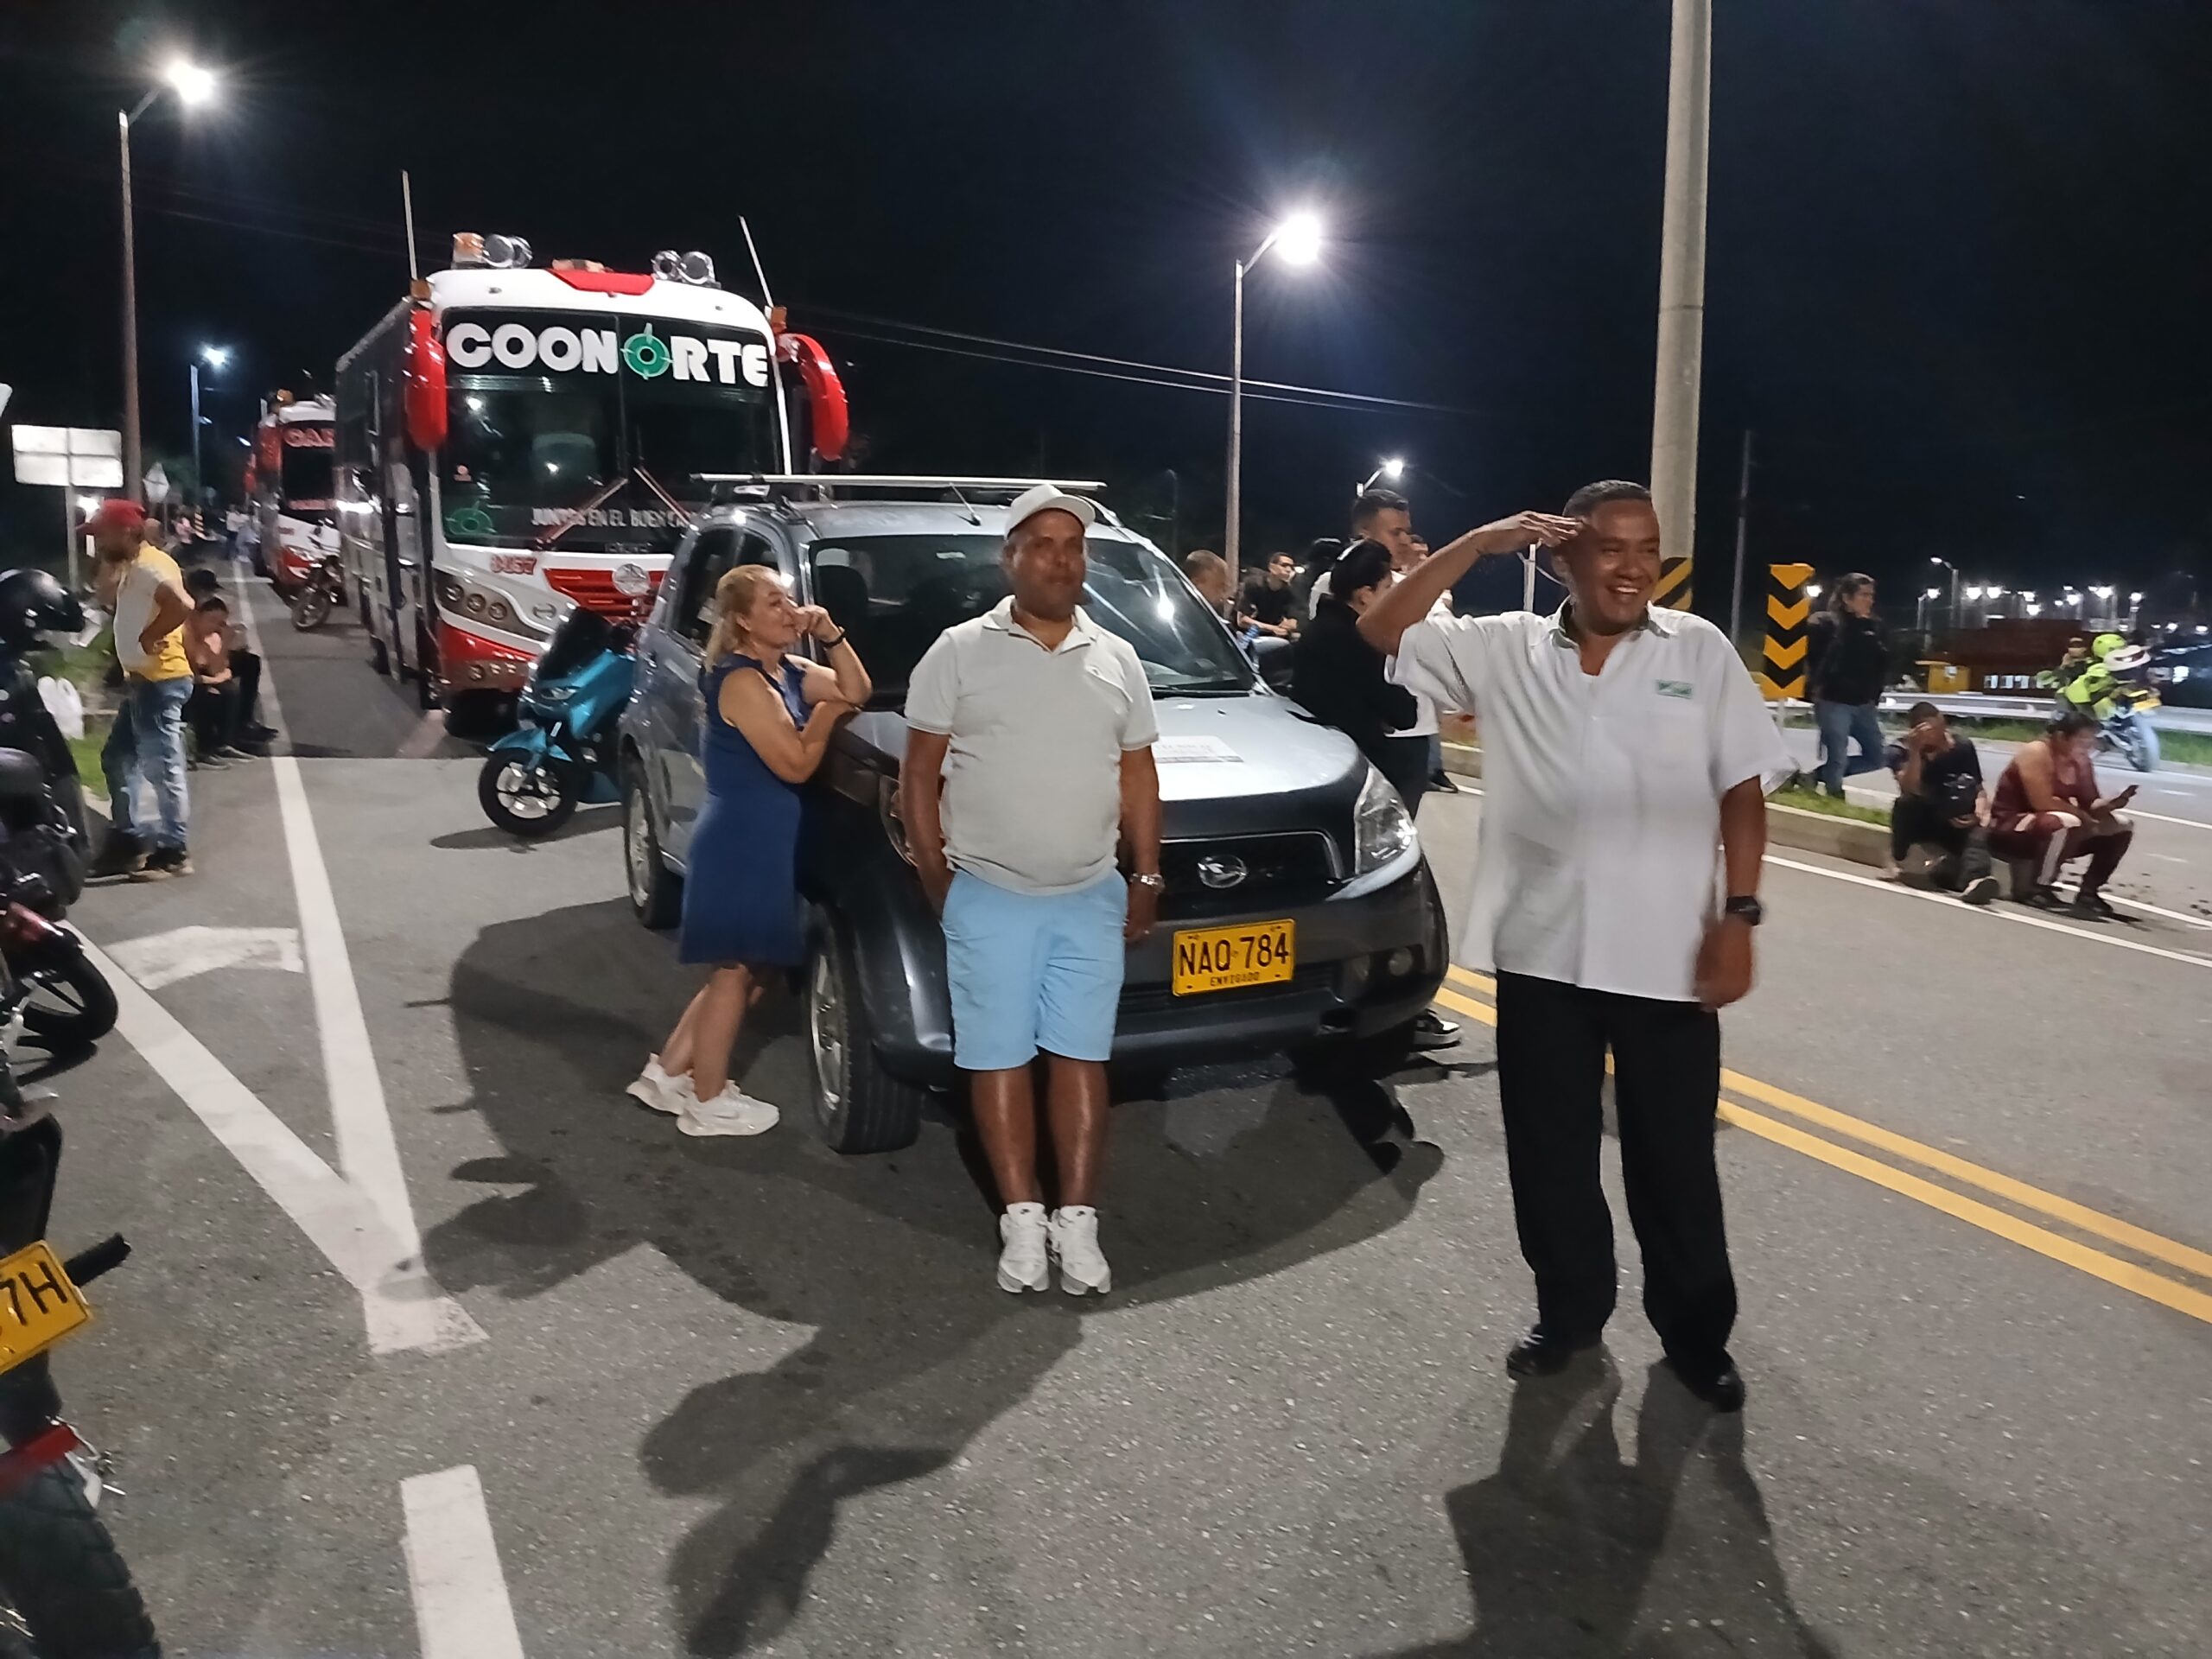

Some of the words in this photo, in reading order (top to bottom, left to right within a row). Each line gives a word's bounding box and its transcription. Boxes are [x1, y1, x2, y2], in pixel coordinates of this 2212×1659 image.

[446, 322, 768, 388] COONORTE
[1238, 932, 1289, 969] 784
[1210, 971, 1260, 987] ENVIGADO
